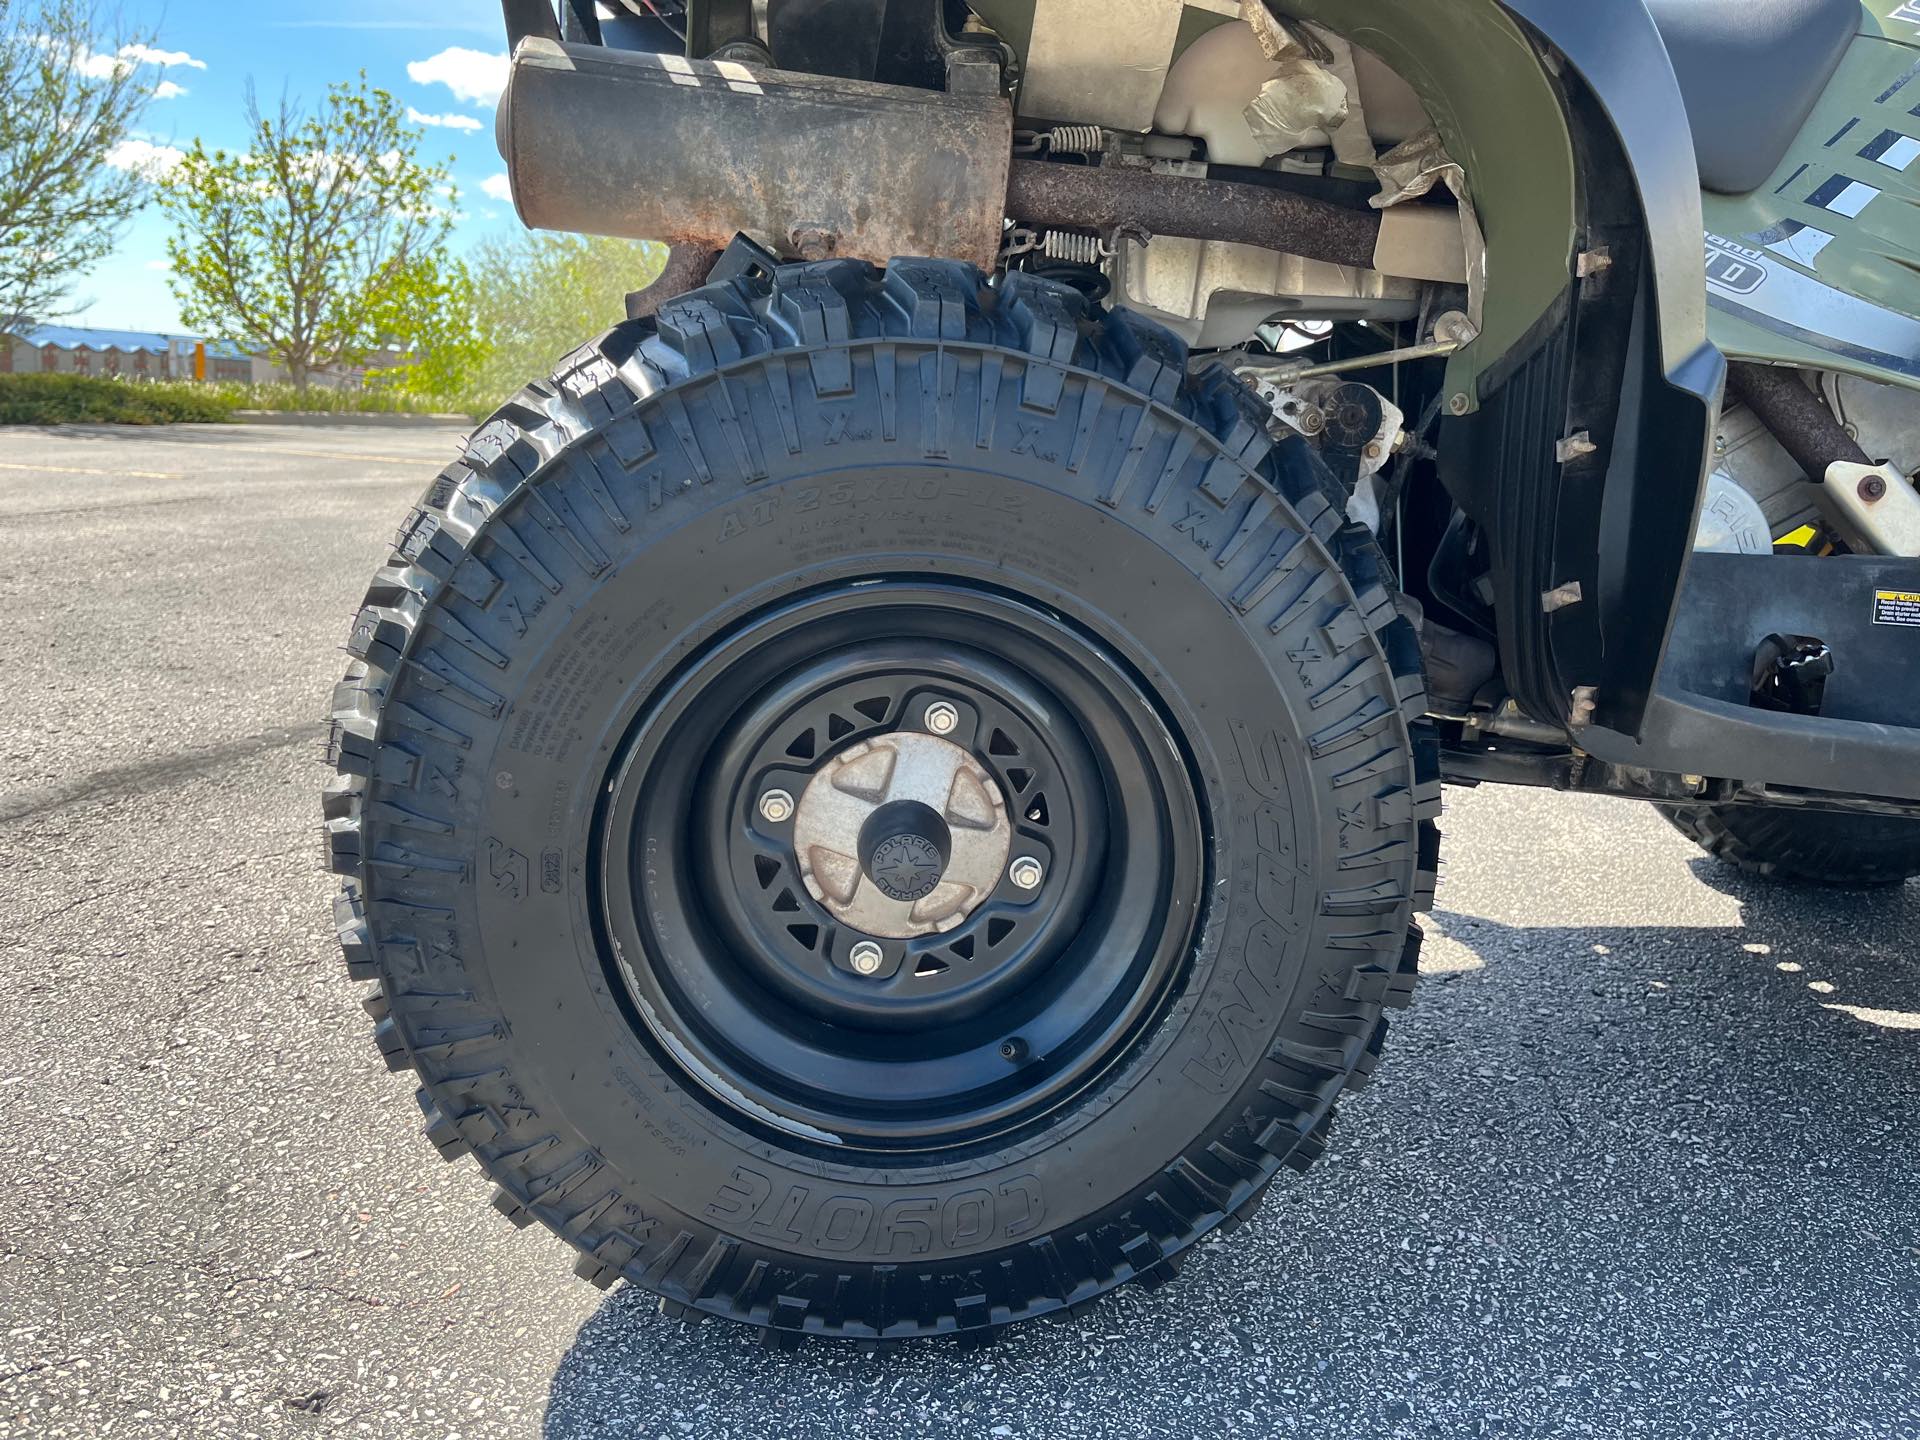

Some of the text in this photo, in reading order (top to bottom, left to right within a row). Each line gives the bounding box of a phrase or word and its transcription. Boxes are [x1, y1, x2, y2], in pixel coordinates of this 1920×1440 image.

[875, 835, 938, 864] POLARIS
[875, 872, 940, 901] POLARIS
[702, 1165, 1047, 1255] COYOTE
